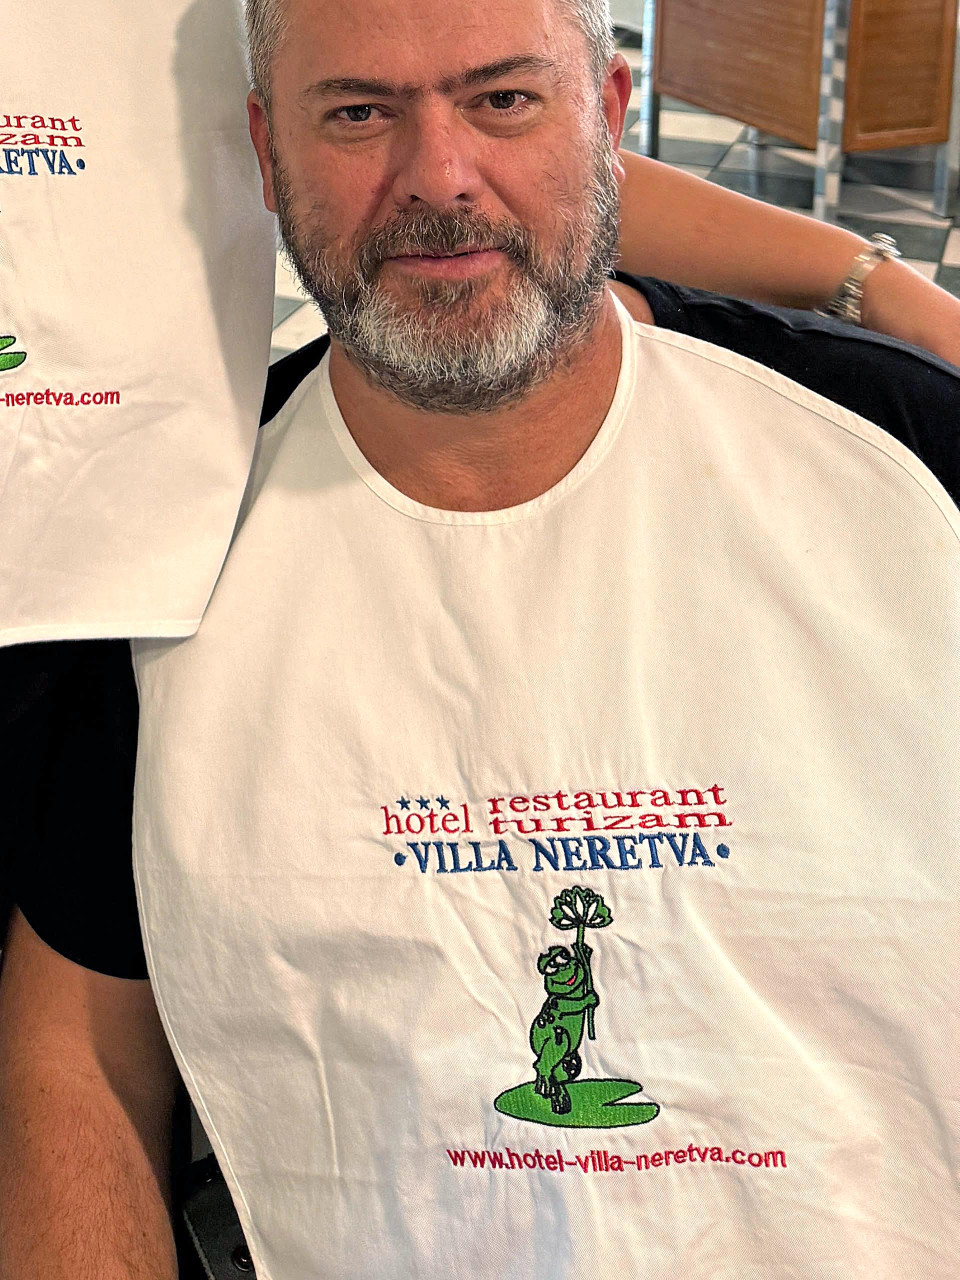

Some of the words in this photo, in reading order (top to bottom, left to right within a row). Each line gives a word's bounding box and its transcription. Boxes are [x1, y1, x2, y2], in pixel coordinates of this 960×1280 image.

[380, 803, 473, 836] hotel
[487, 783, 728, 815] restaurant
[487, 810, 733, 835] turizam
[406, 839, 518, 874] VILLA
[530, 832, 716, 872] NERETVA
[446, 1143, 788, 1174] www.hotel-villa-neretva.com
